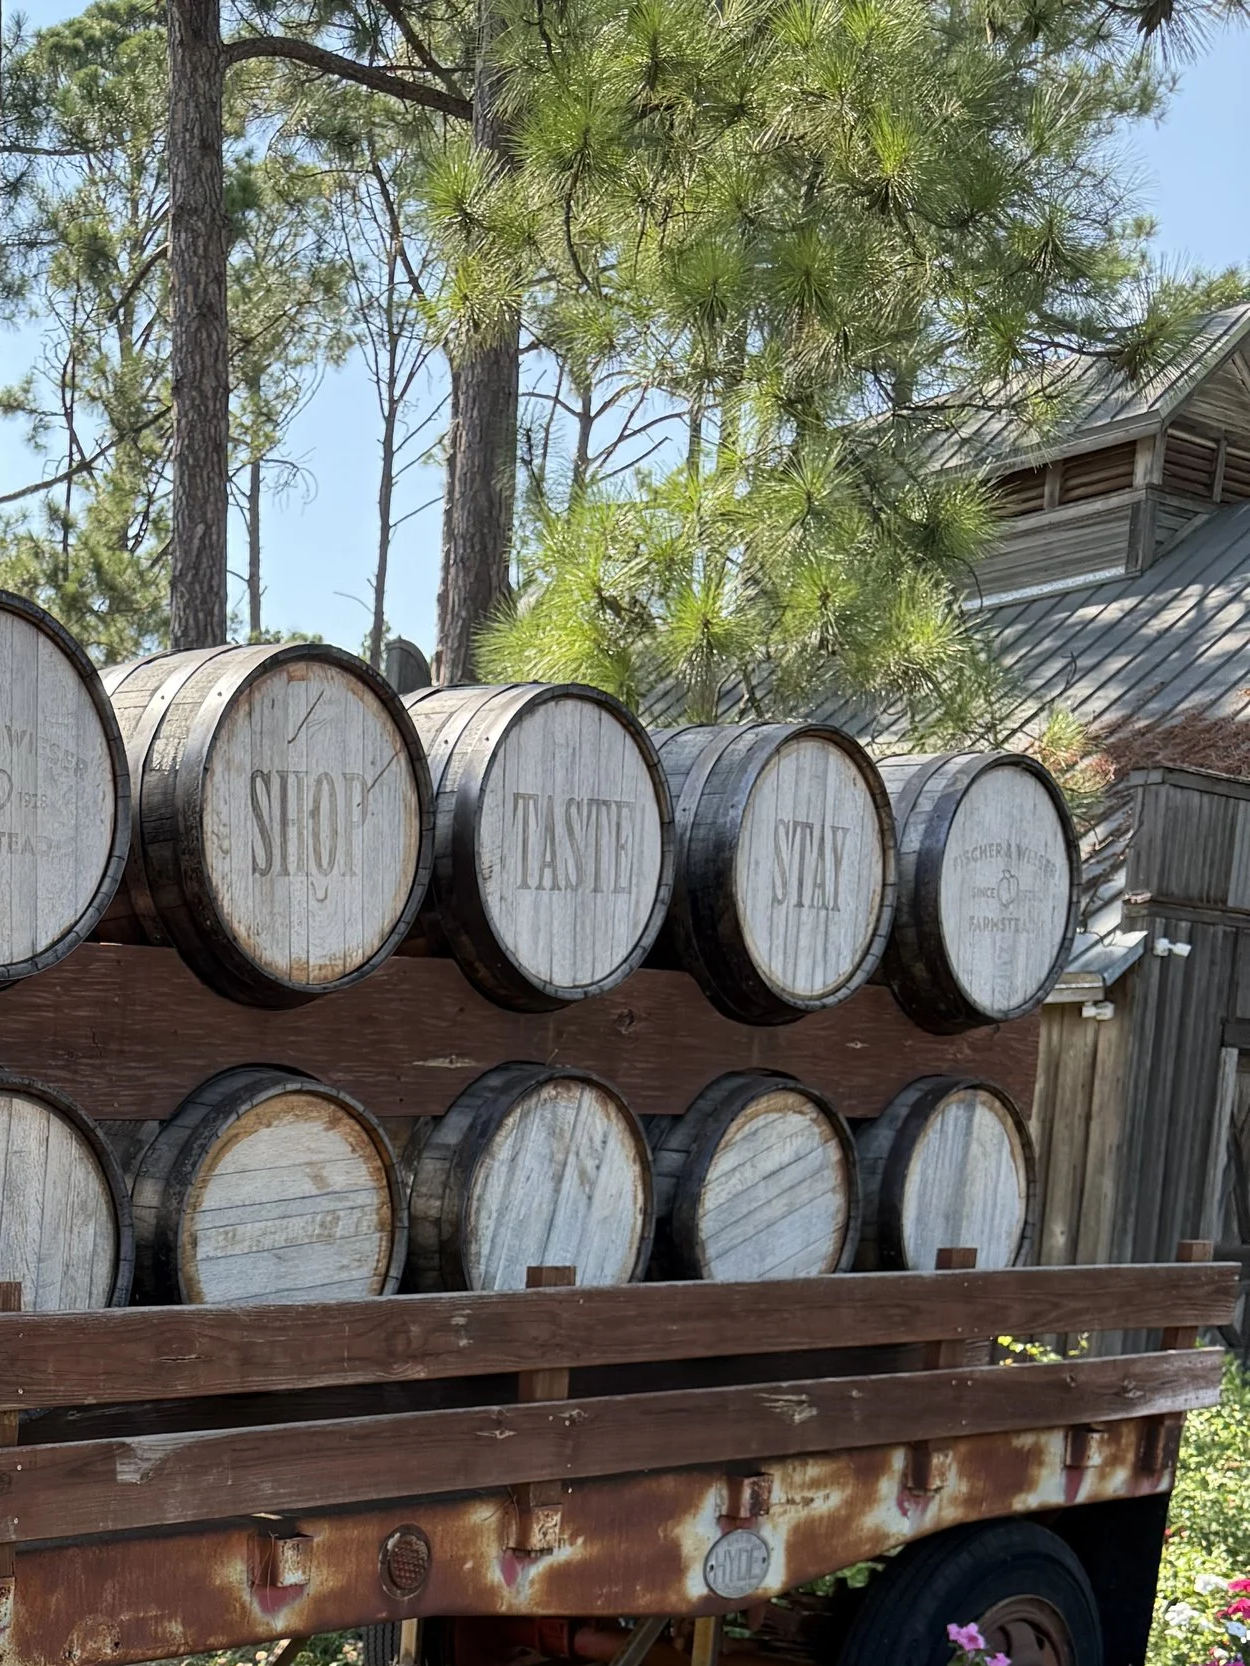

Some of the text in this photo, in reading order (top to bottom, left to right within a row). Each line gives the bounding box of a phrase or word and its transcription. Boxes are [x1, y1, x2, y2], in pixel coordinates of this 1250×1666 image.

[249, 769, 368, 879] SHOP
[512, 792, 637, 895] TASTE
[771, 818, 851, 914] STAY
